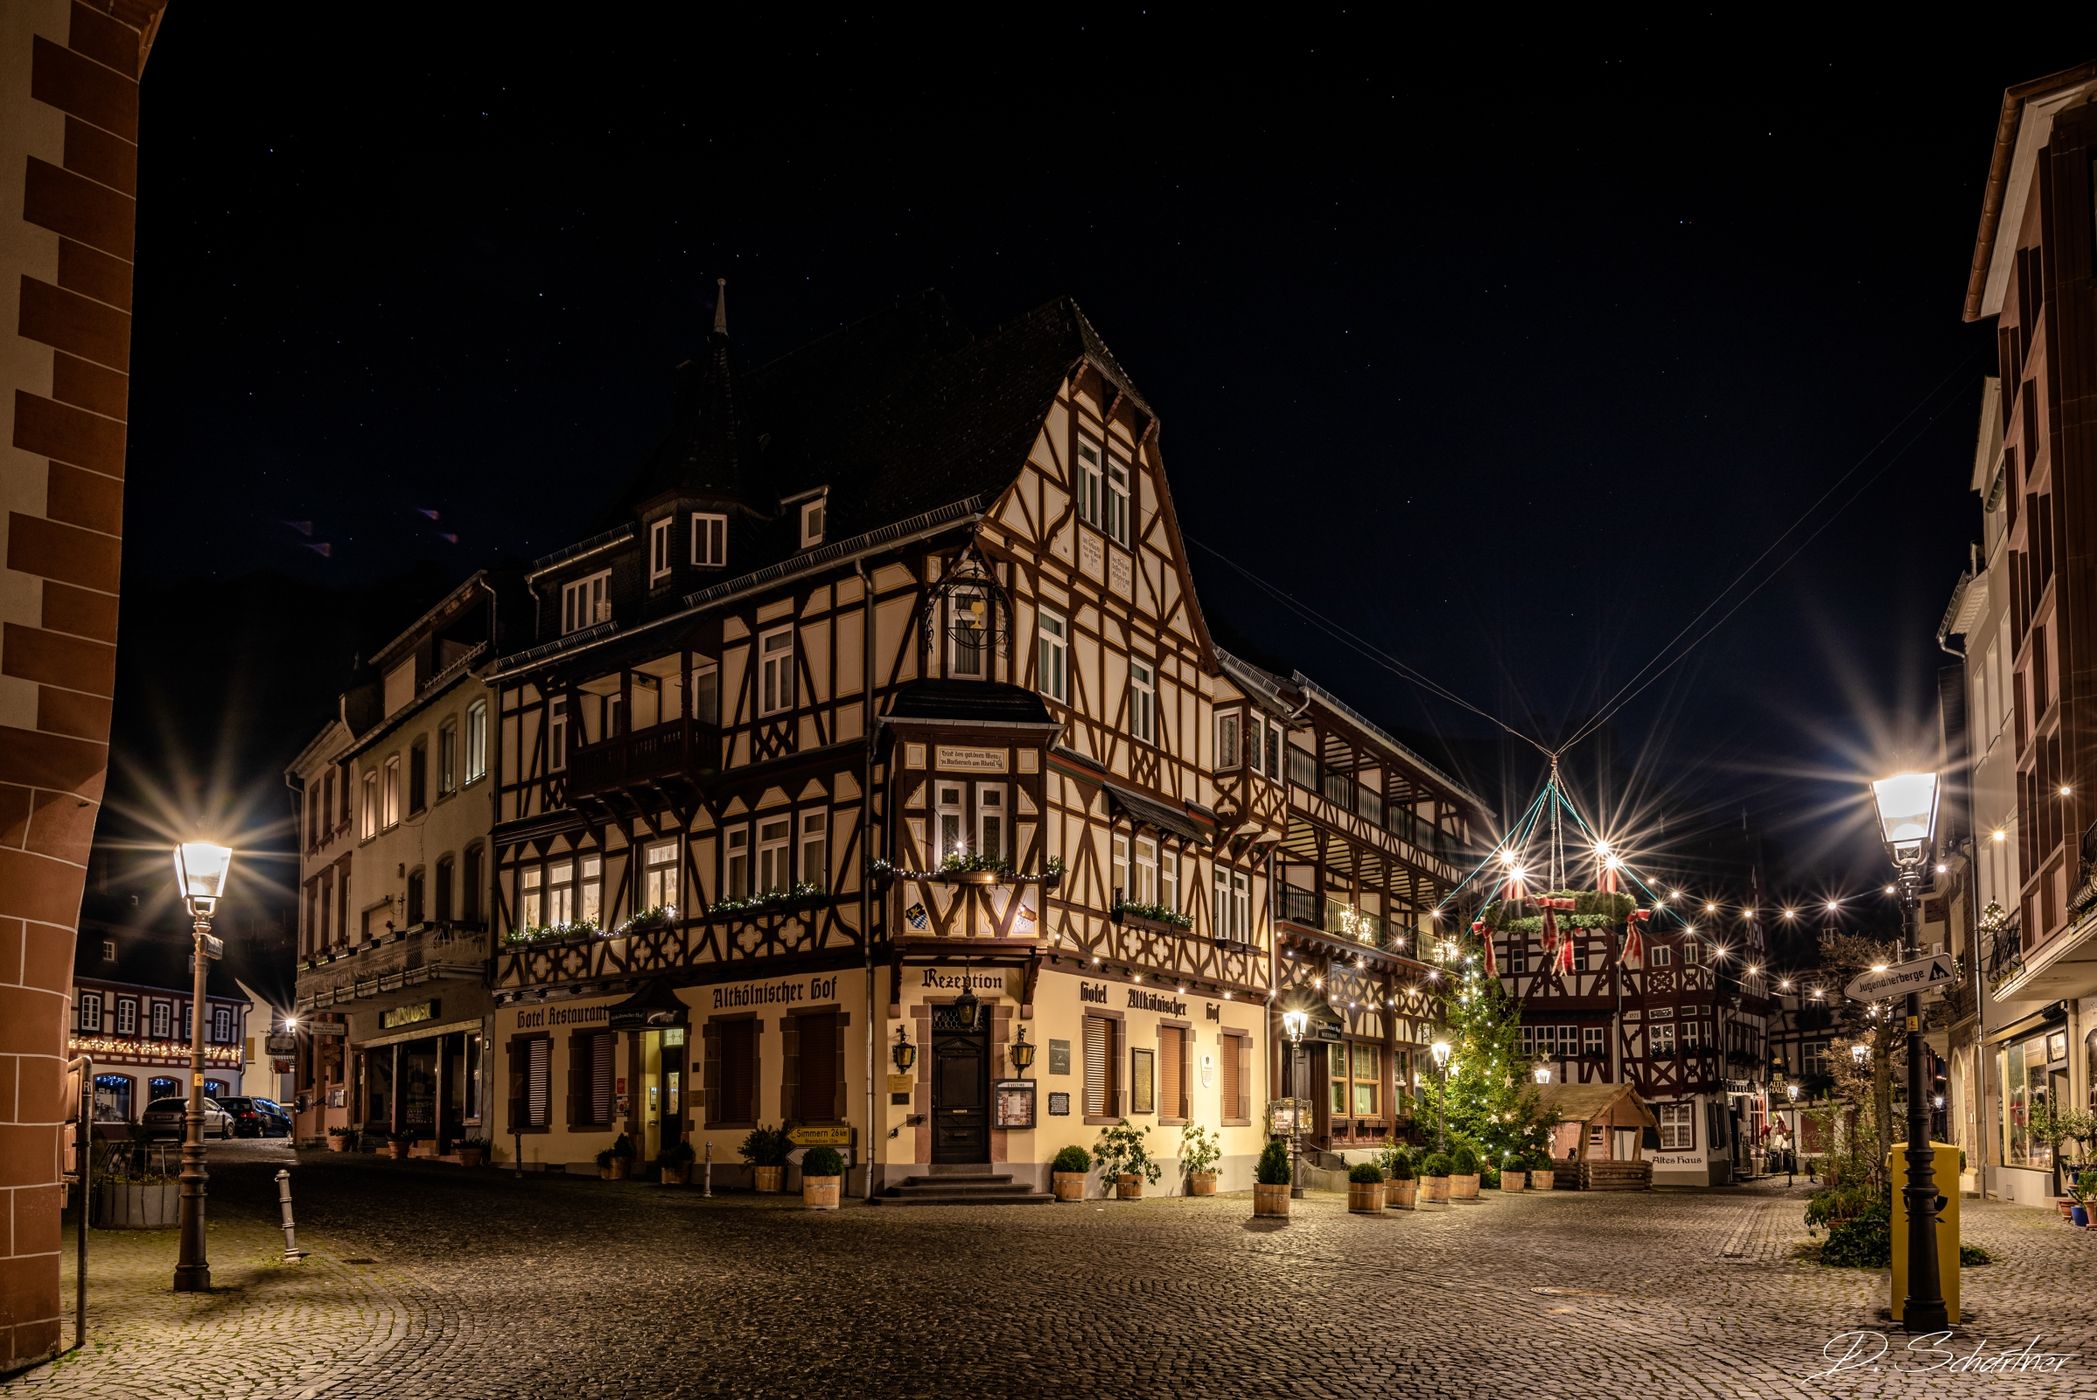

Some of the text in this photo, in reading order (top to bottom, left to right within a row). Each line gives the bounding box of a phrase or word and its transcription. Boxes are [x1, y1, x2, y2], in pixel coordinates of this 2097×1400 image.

[922, 968, 1002, 989] Rezeption
[1859, 970, 1925, 992] Jugendherberge
[713, 975, 838, 1009] Altkölnischer Hof
[1080, 981, 1220, 1024] Hotel Altkölnischer Hof
[517, 1003, 608, 1029] Hotel Restaurant
[797, 1130, 828, 1138] Simmern
[831, 1129, 839, 1137] 26
[1653, 1156, 1702, 1164] Altes Haus
